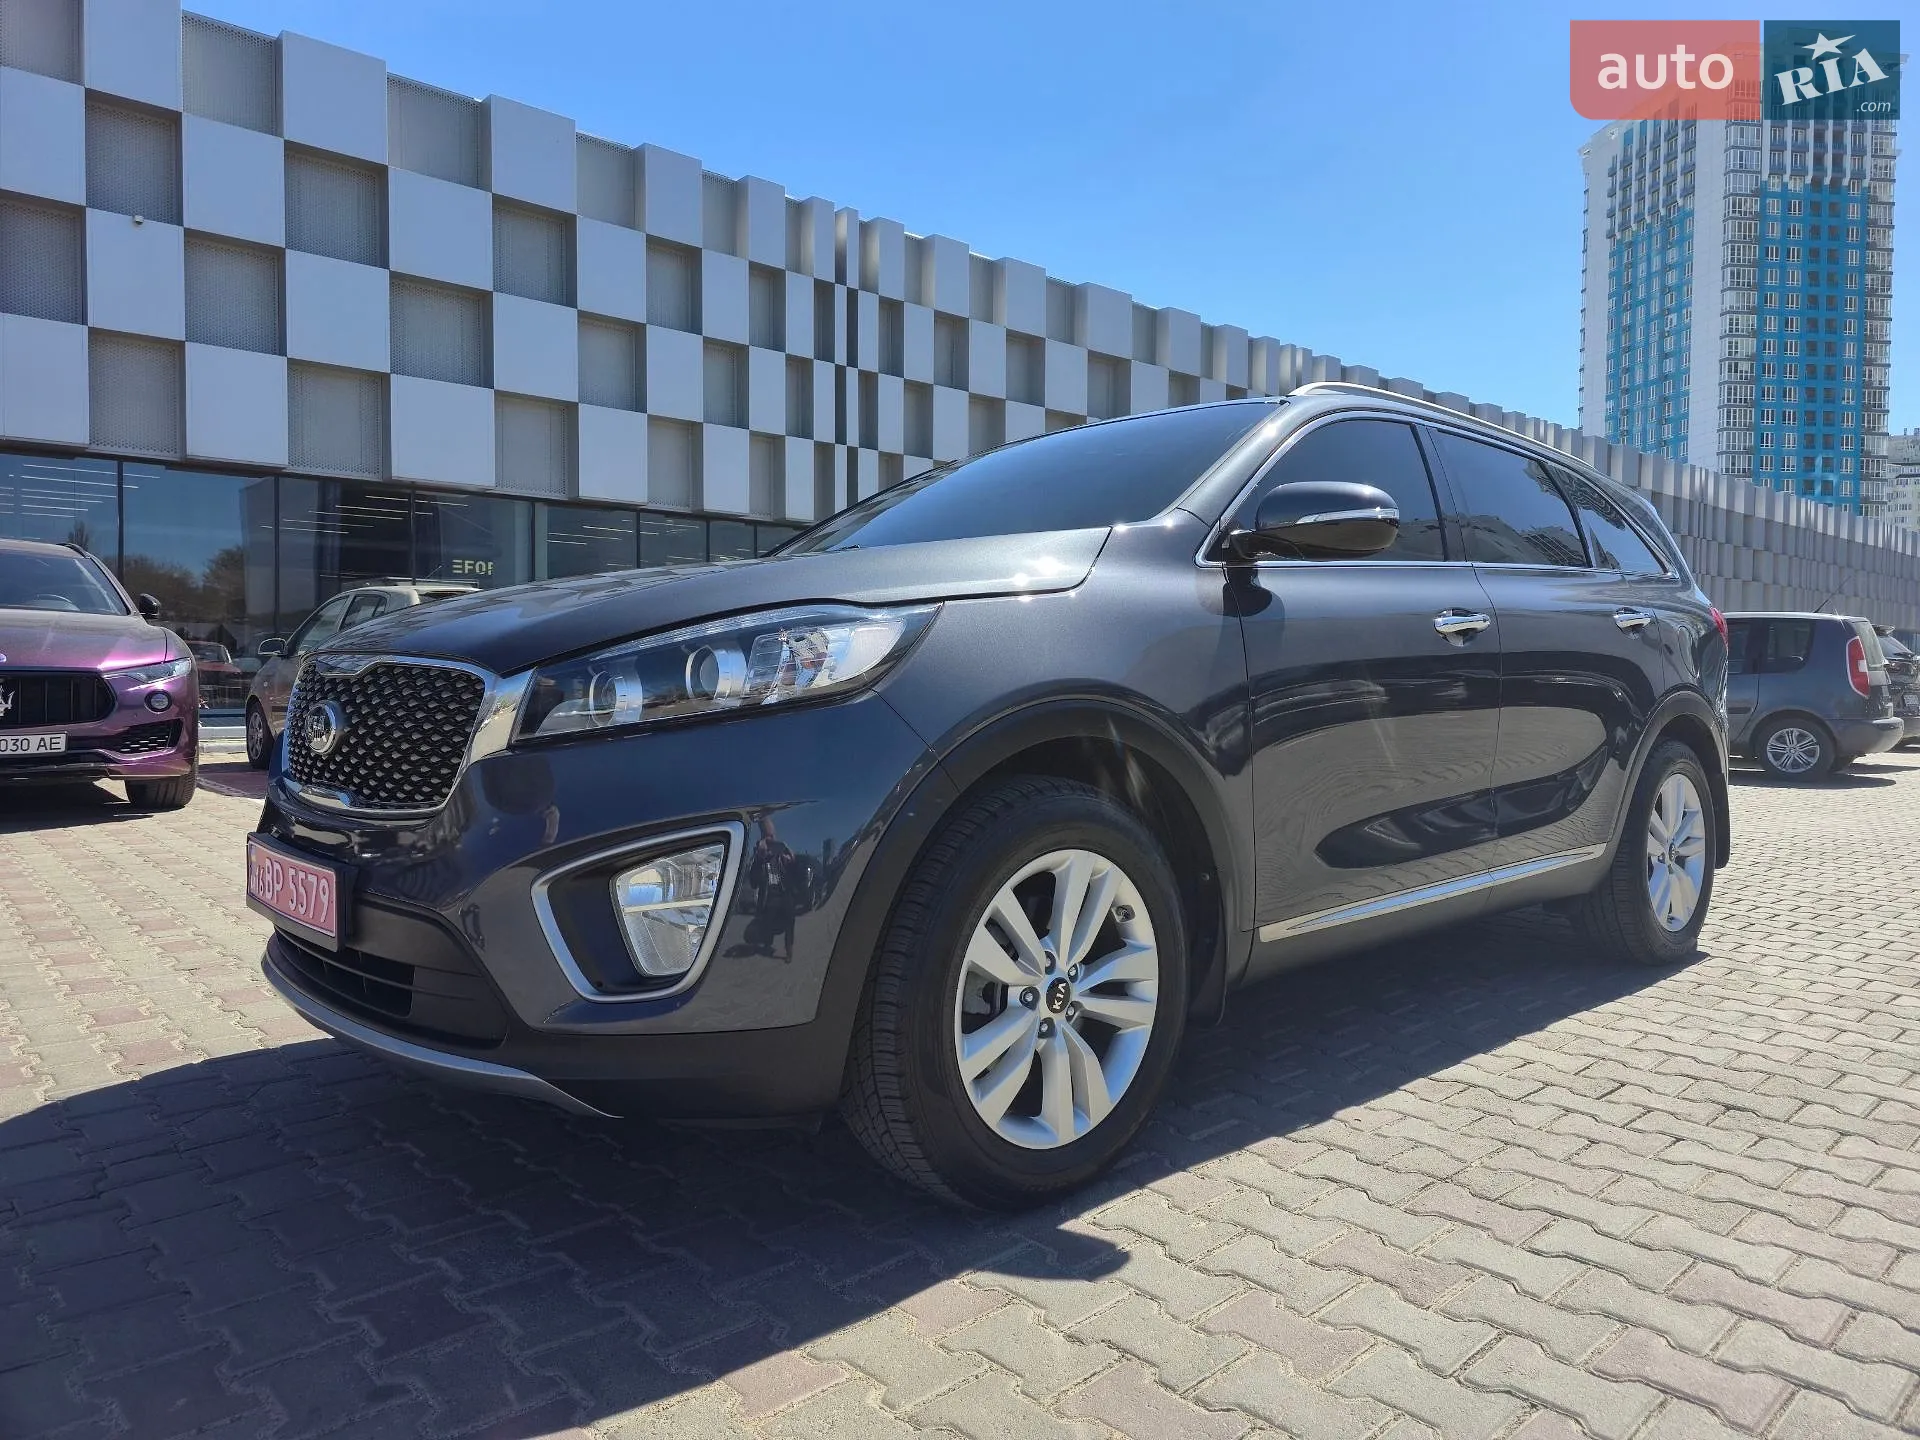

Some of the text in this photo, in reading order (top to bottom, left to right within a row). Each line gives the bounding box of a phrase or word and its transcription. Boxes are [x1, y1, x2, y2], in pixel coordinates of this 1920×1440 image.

[36, 736, 62, 751] AE
[288, 866, 330, 924] 5579
[1052, 982, 1067, 1010] KIA
